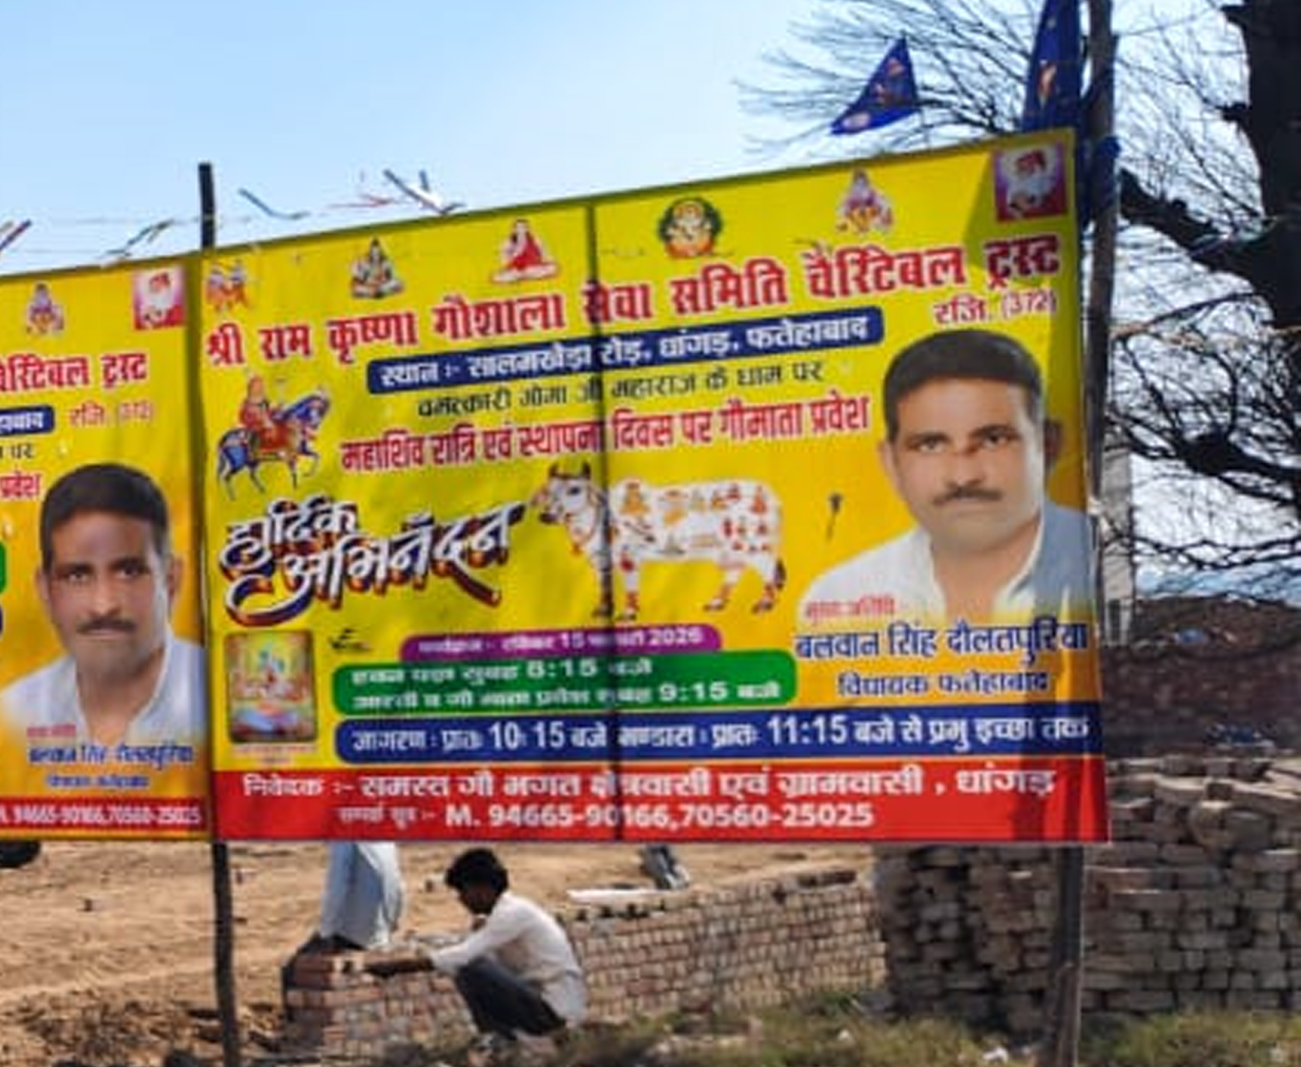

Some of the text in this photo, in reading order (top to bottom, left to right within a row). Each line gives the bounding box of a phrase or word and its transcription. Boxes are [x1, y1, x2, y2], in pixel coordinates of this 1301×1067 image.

[207, 321, 244, 366] श्री
[259, 324, 312, 361] राम
[326, 312, 418, 364] कृष्णा
[431, 292, 566, 341] गौशाला
[583, 281, 652, 325] सेवा
[670, 258, 789, 314] समिति
[985, 234, 1060, 290] ट्रस्ट
[381, 362, 439, 387] स्थान
[746, 316, 869, 349] फतेहाबाद
[611, 374, 696, 399] महाराज
[791, 361, 823, 382] पर
[340, 428, 425, 471] महाशिव
[429, 422, 476, 465] रात्रि
[481, 422, 513, 460] एवं
[517, 420, 603, 456] स्थापना
[612, 408, 674, 449] दिवस
[680, 410, 713, 444] पर
[808, 389, 869, 434] प्रवेश
[795, 631, 880, 660] बलवान
[888, 622, 937, 658] सिंह
[571, 720, 607, 748] बजे
[767, 715, 848, 745] 11:15
[853, 715, 895, 743] बजे
[899, 713, 923, 742] से
[719, 765, 770, 799] एवं
